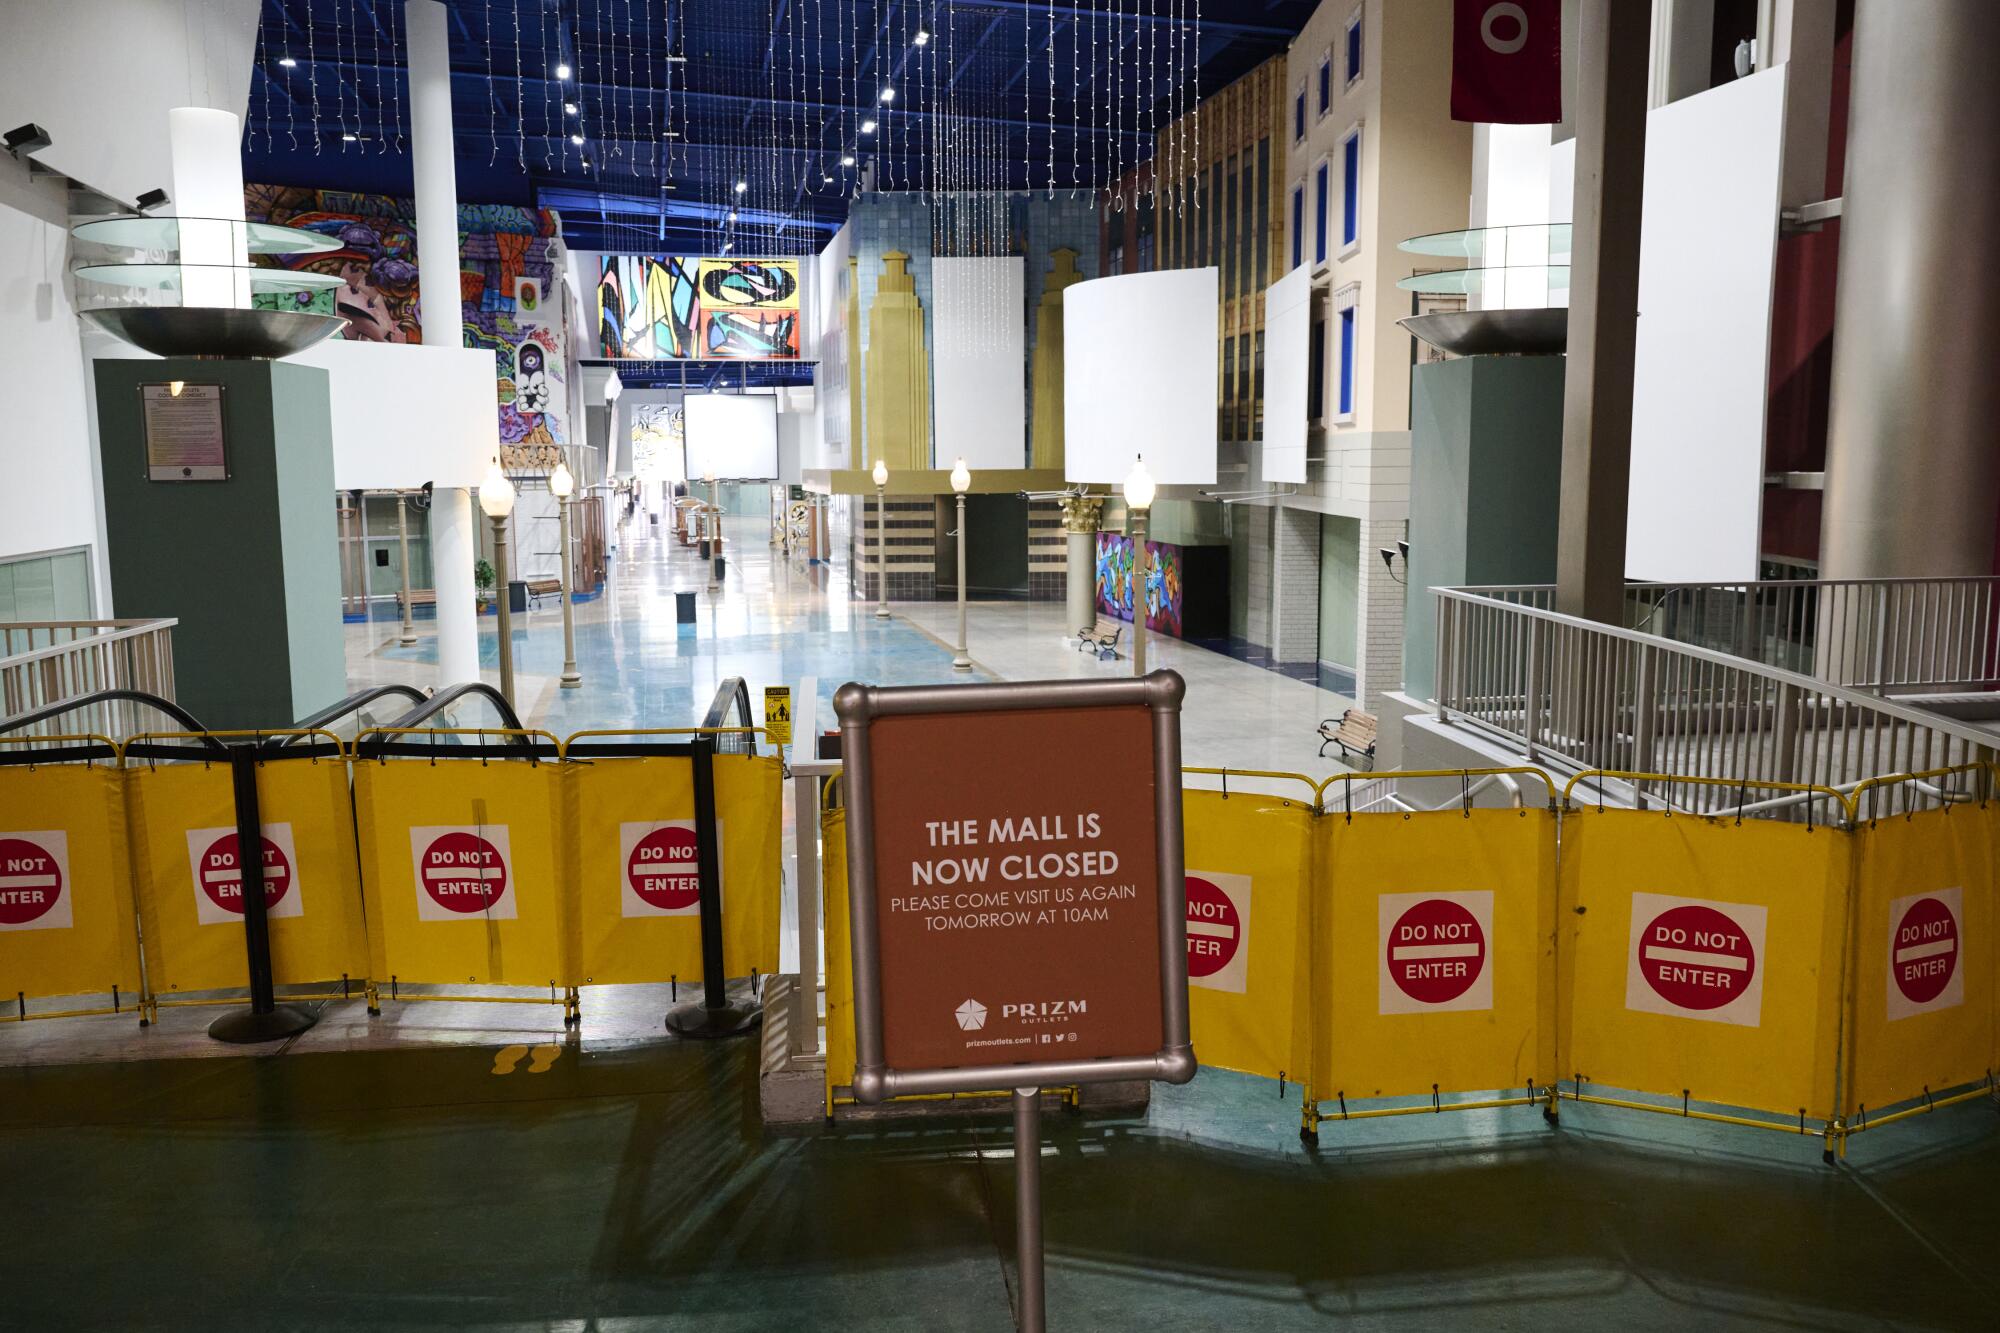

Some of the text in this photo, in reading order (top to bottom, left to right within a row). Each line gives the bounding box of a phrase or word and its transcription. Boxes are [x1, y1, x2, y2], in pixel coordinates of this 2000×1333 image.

[926, 813, 1101, 847] THE MALL IS
[210, 853, 234, 867] DO
[431, 851, 493, 864] DO NOT
[640, 846, 698, 860] DO NO
[7, 858, 47, 872] NOT
[912, 850, 1119, 886] NOW CLOSED
[219, 881, 276, 898] ENR
[438, 882, 493, 895] ENTER
[644, 878, 700, 891] ENTER
[0, 890, 45, 905] NTER
[891, 884, 1136, 912] PLEASE COME VISIT US AGAIN
[925, 907, 1109, 931] TOMORROW AT 10AM
[1188, 901, 1228, 919] NOT
[1401, 923, 1472, 941] DO NOT
[1656, 926, 1740, 951] DO NOT
[1902, 919, 1950, 943] DO NOT
[1186, 938, 1221, 956] TER
[1406, 962, 1467, 979] ENTER
[1659, 966, 1732, 989] ENTER
[1905, 960, 1946, 982] ENTER
[1002, 1000, 1087, 1018] PRIZM
[1021, 1016, 1069, 1024] OUTLETS
[966, 1036, 1031, 1048] prizmoutlets.com
